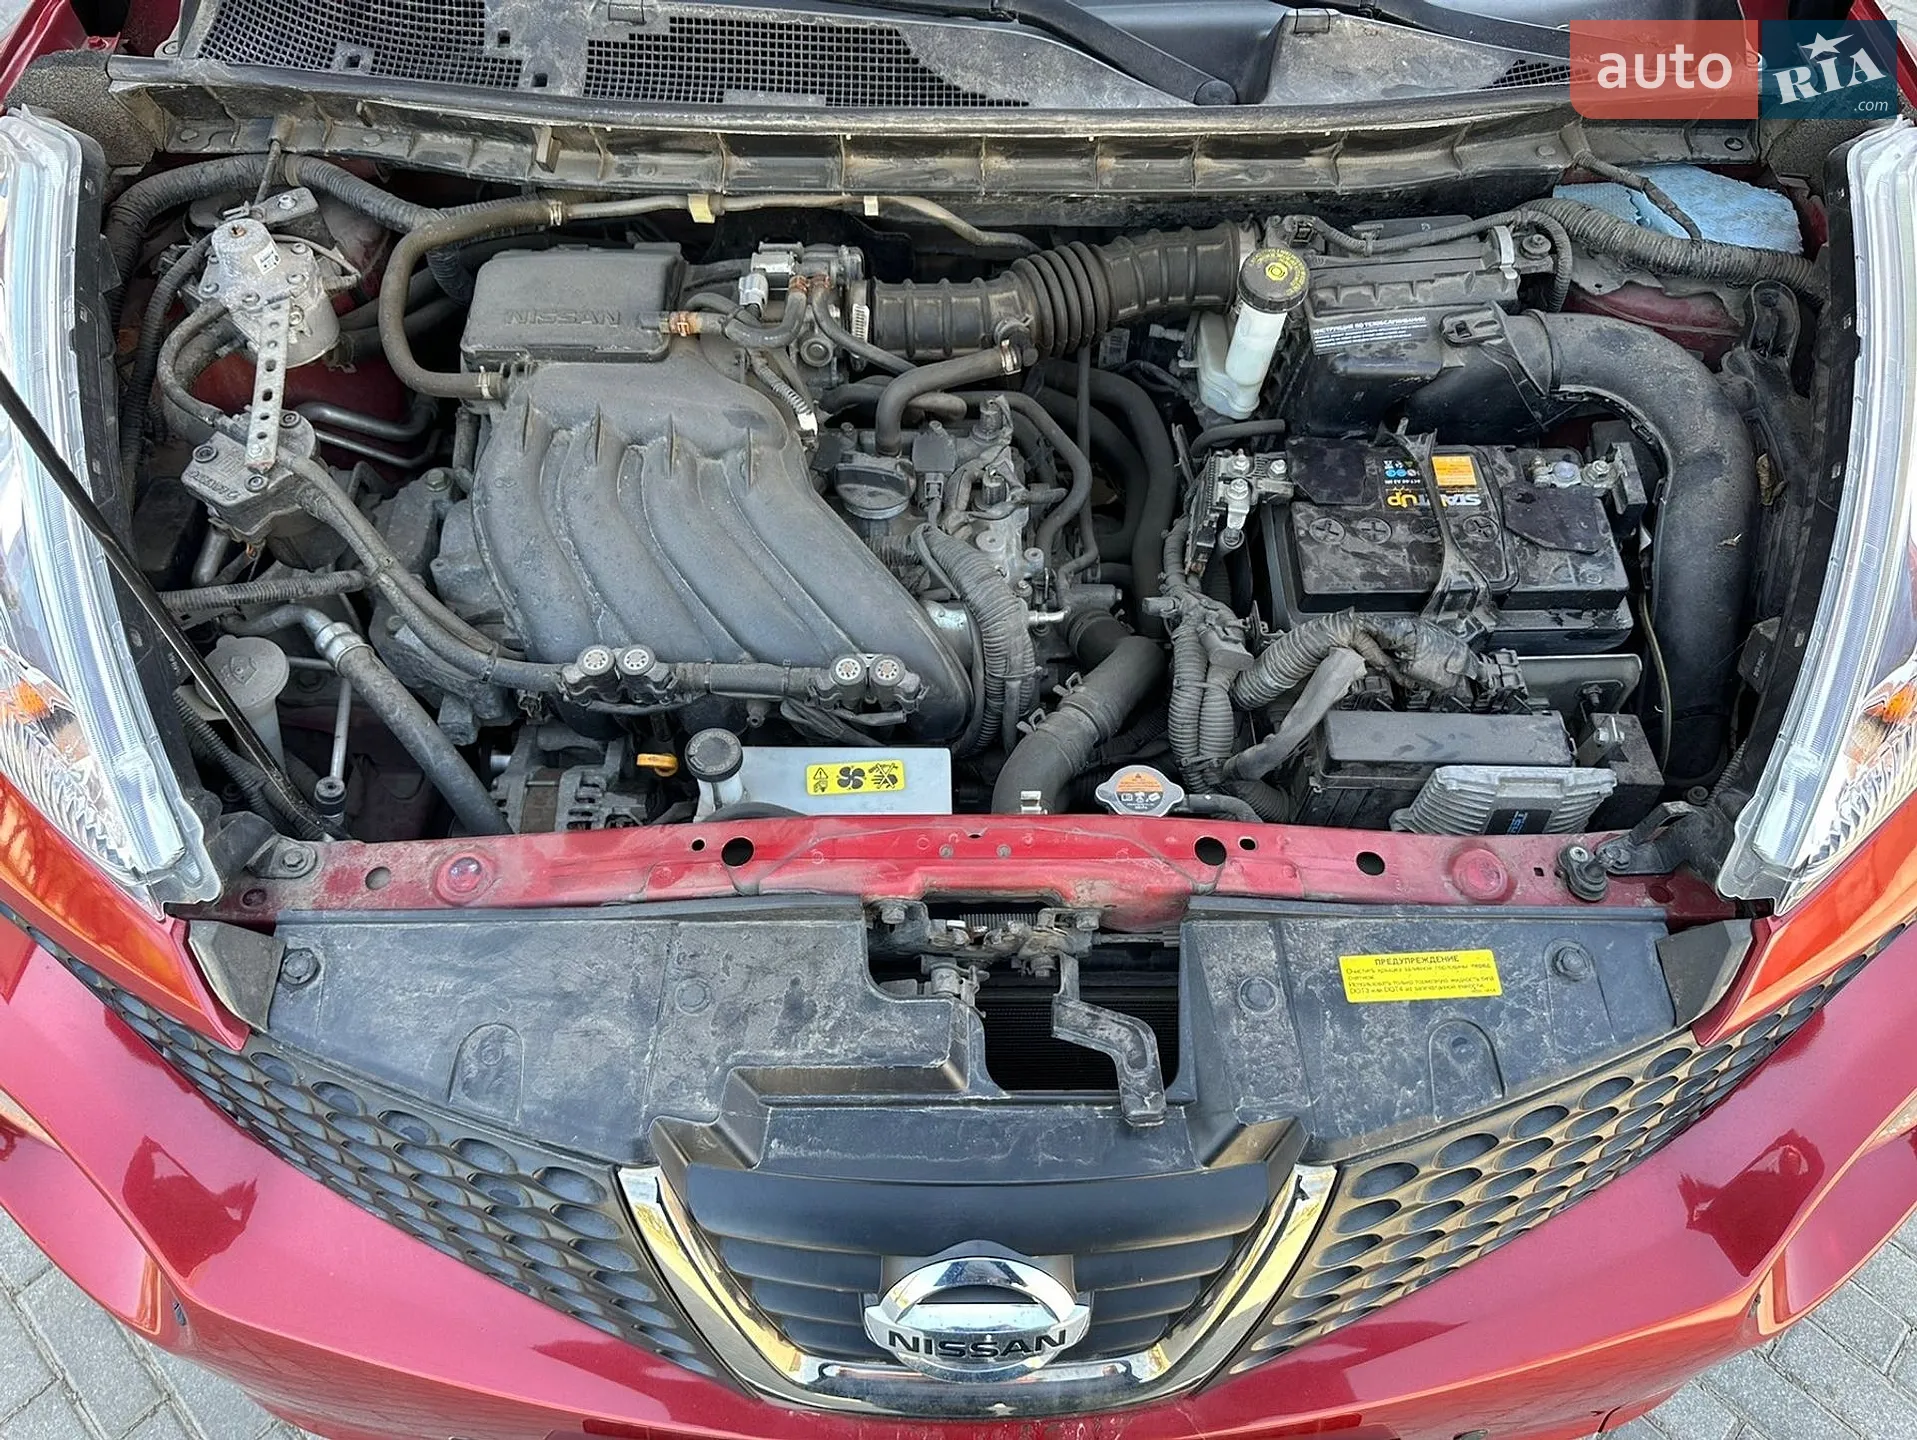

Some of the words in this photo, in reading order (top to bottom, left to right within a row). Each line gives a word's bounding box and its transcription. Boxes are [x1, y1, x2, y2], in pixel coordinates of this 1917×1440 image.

[505, 309, 622, 326] NISSAN
[1374, 955, 1460, 966] ПРЕДУПРЕЖДЕНИЕ
[888, 1329, 1067, 1358] NISSAN
